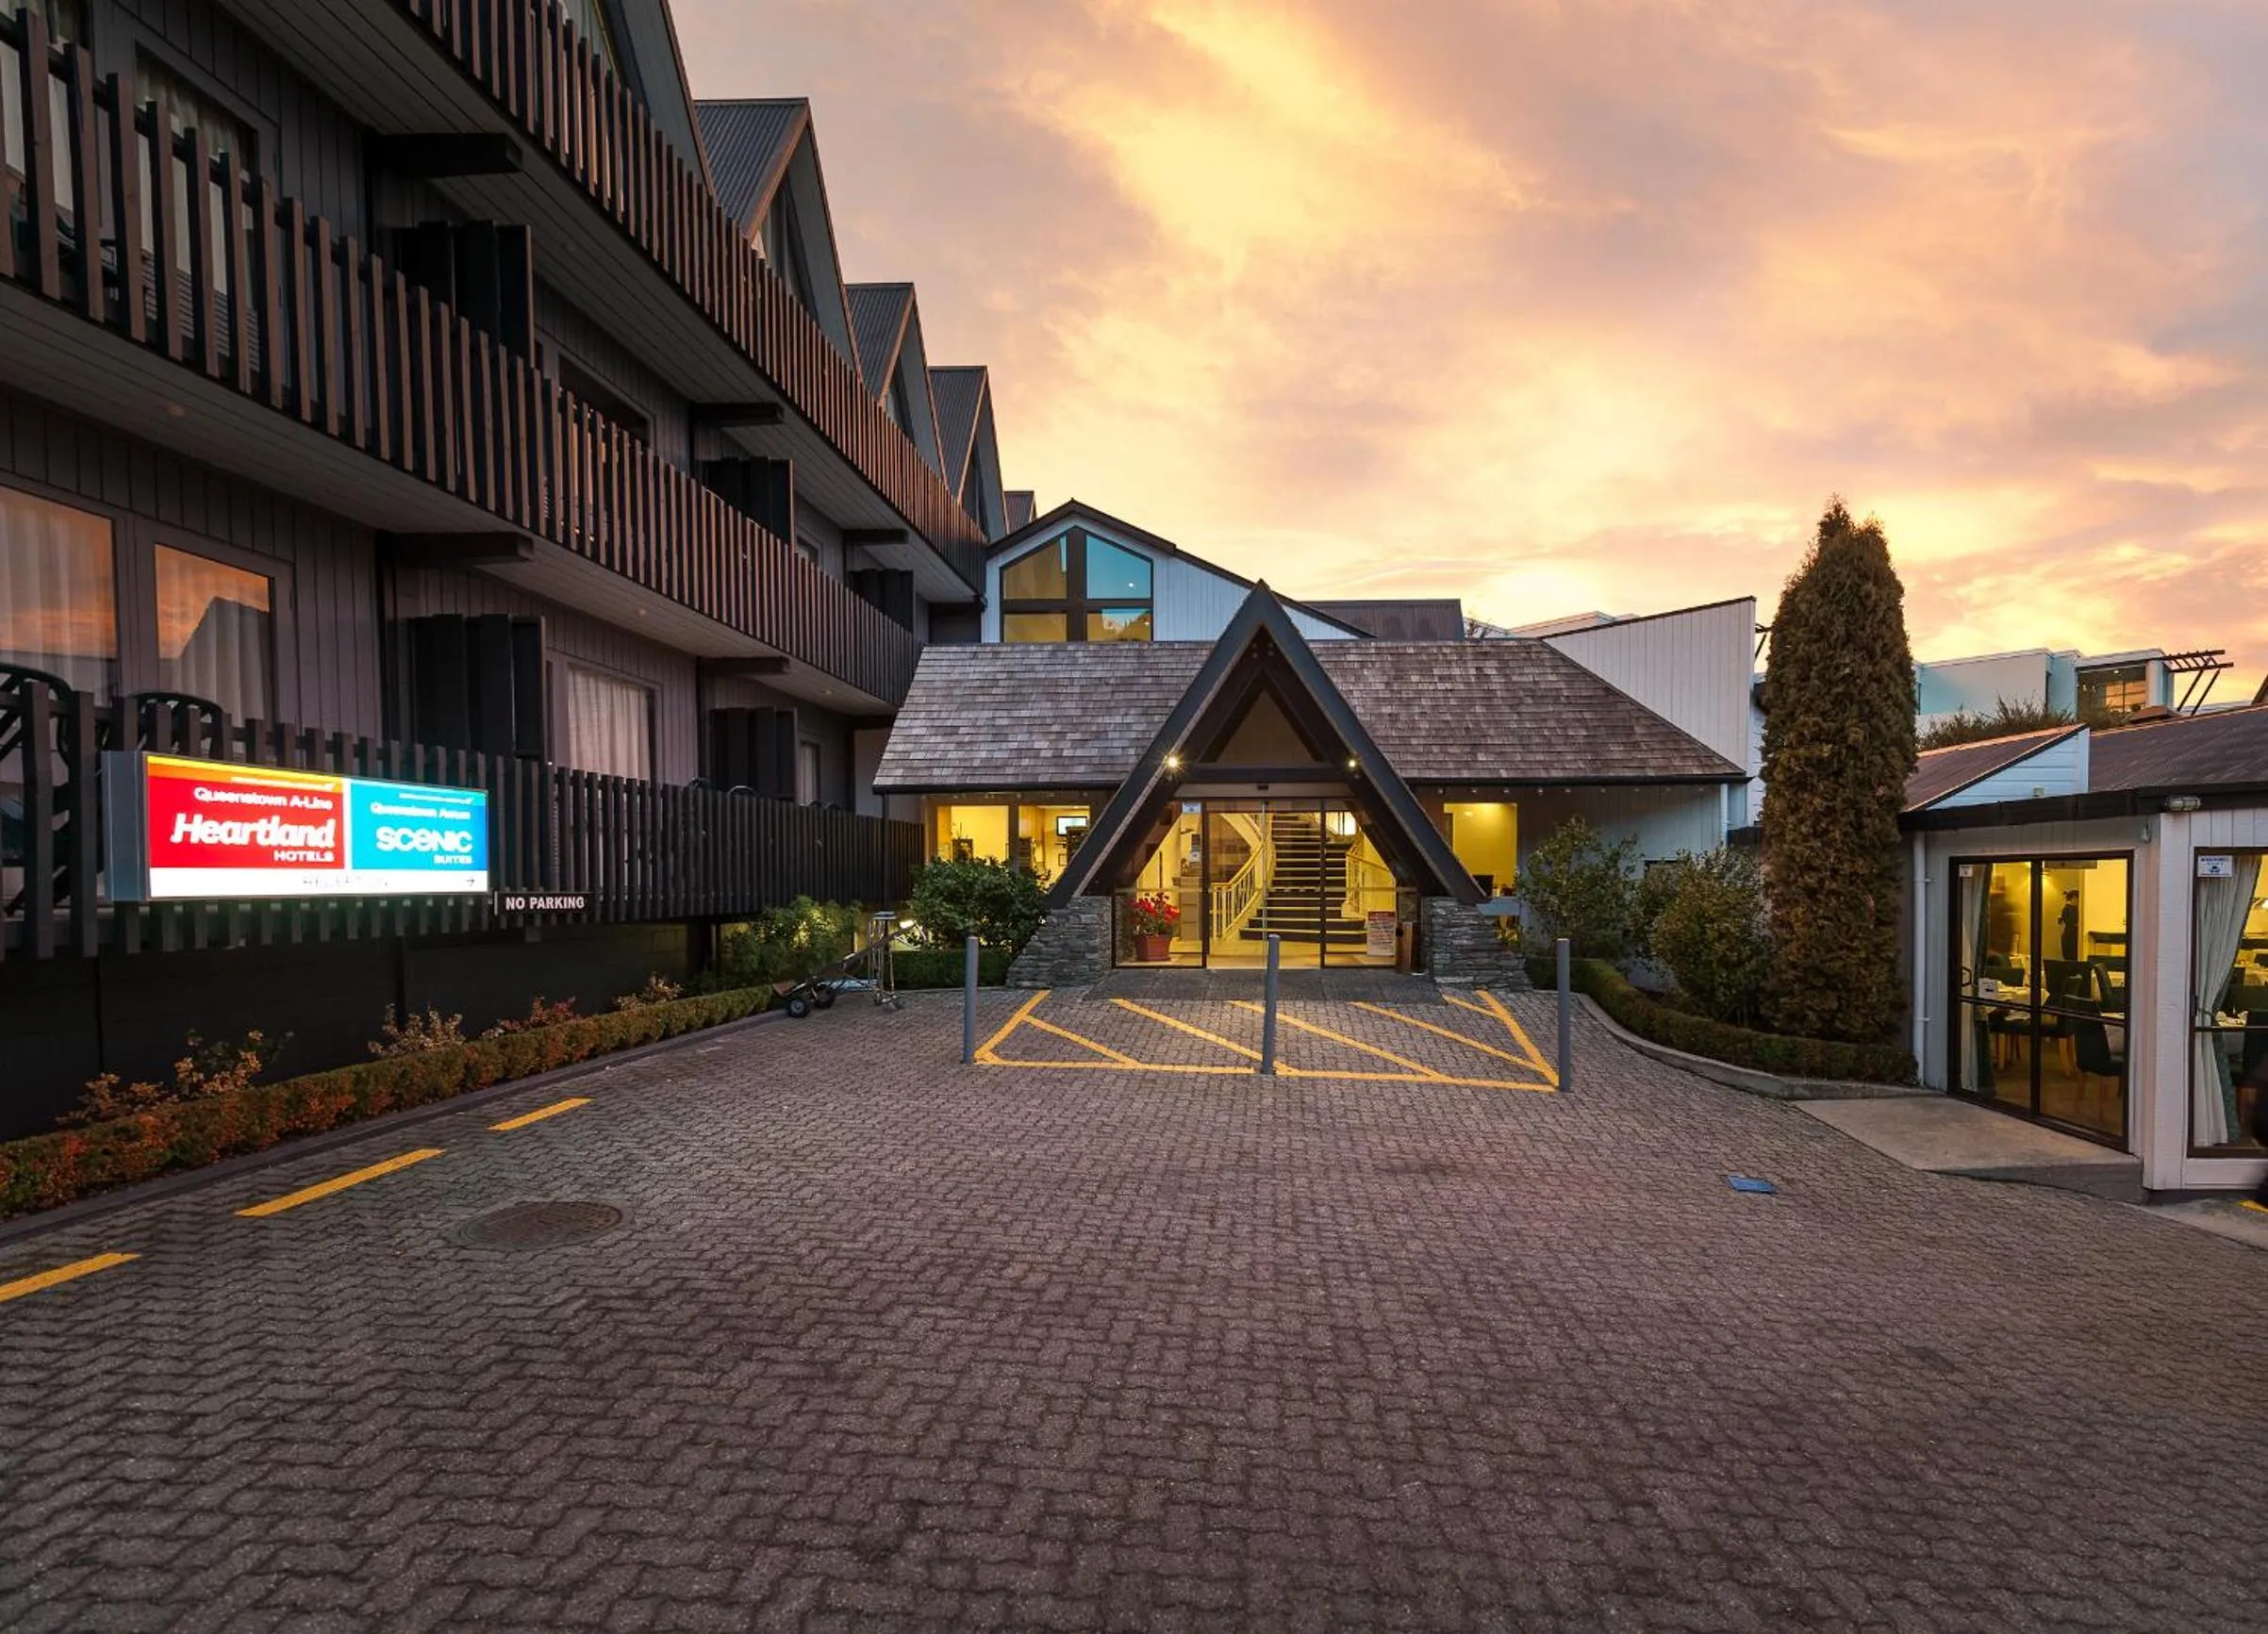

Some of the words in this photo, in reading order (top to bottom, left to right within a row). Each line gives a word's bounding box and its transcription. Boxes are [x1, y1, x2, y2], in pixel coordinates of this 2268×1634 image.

[194, 787, 287, 806] Queenstown
[170, 813, 336, 848] Heartland
[273, 850, 335, 862] HOTELS
[505, 897, 525, 910] NO
[530, 896, 585, 910] PARKING
